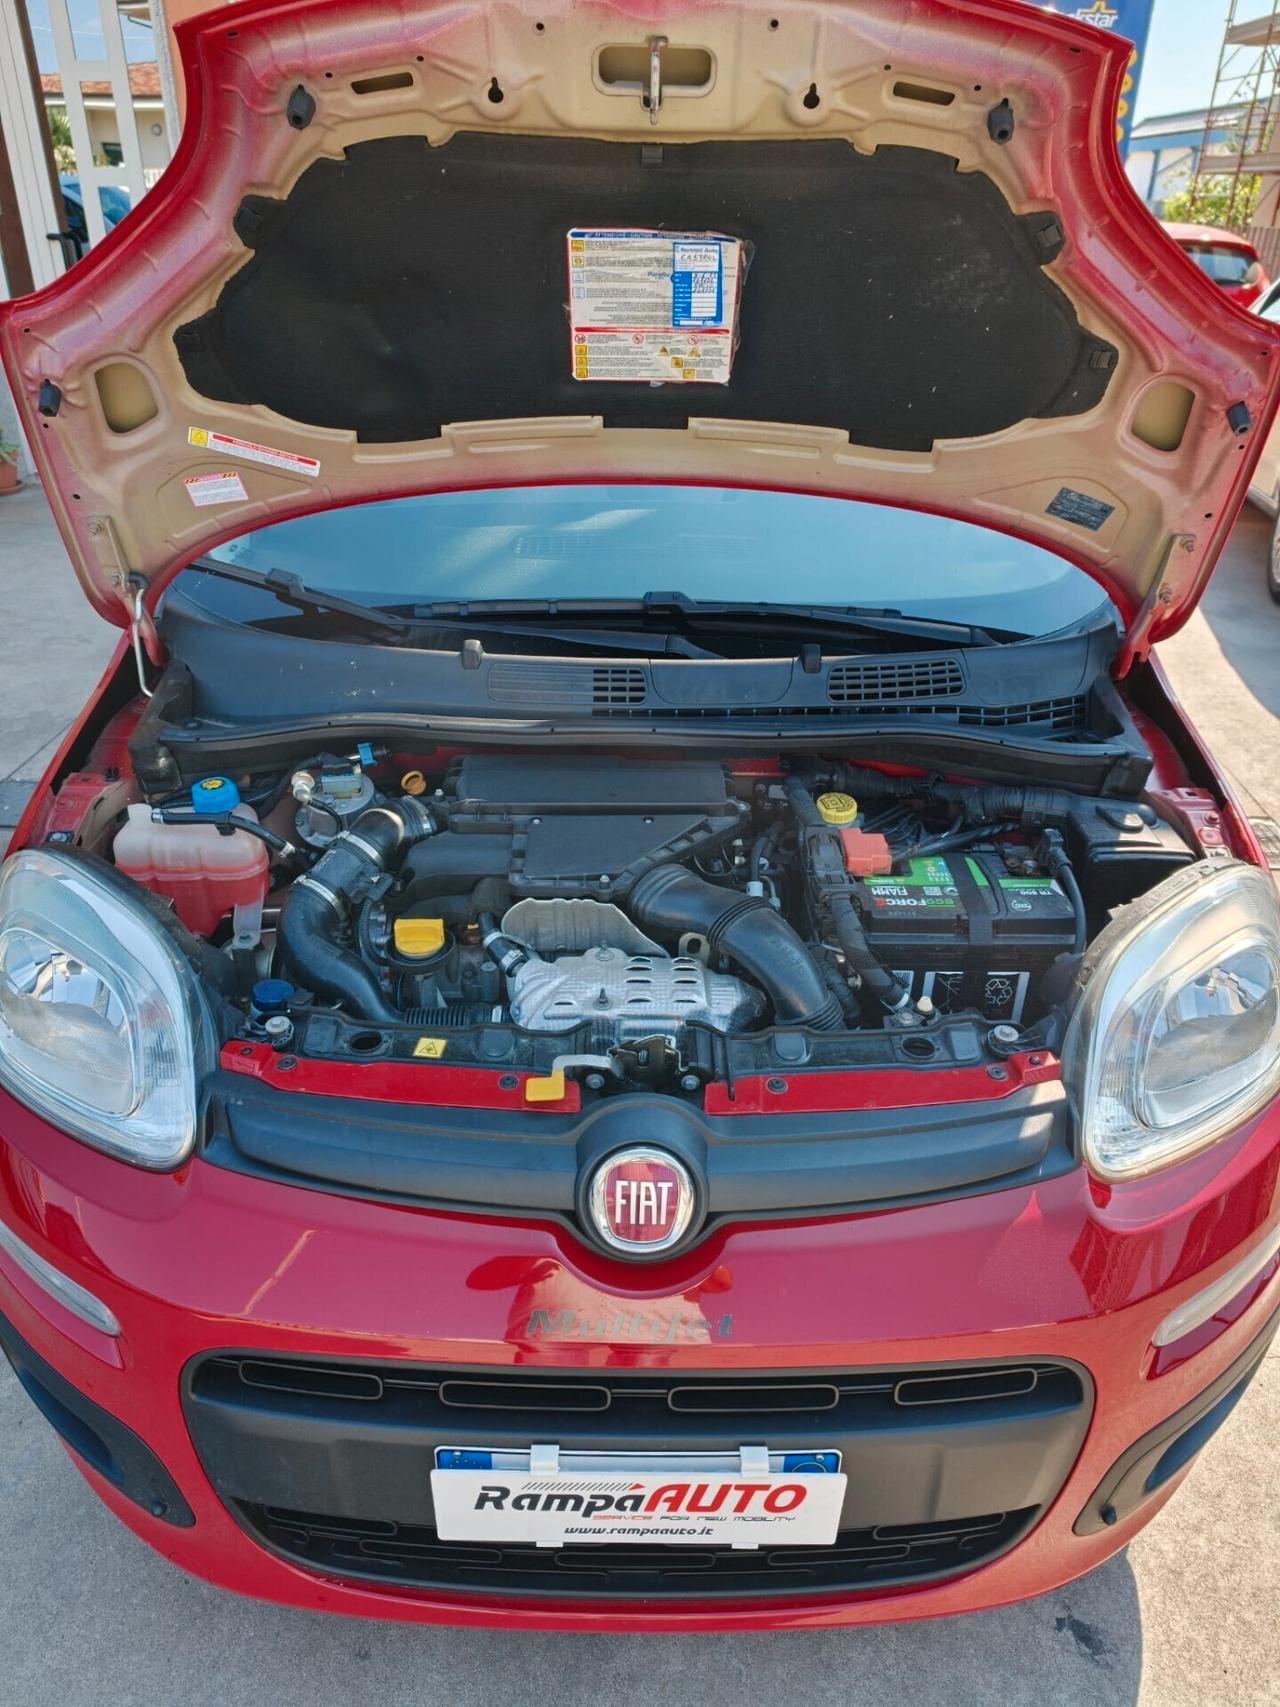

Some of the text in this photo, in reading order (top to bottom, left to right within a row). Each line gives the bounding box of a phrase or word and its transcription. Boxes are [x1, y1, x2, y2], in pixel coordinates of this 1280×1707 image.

[871, 886, 908, 896] FIAMM
[615, 1180, 673, 1225] FIAT
[564, 1526, 714, 1537] www.rampaauto.it
